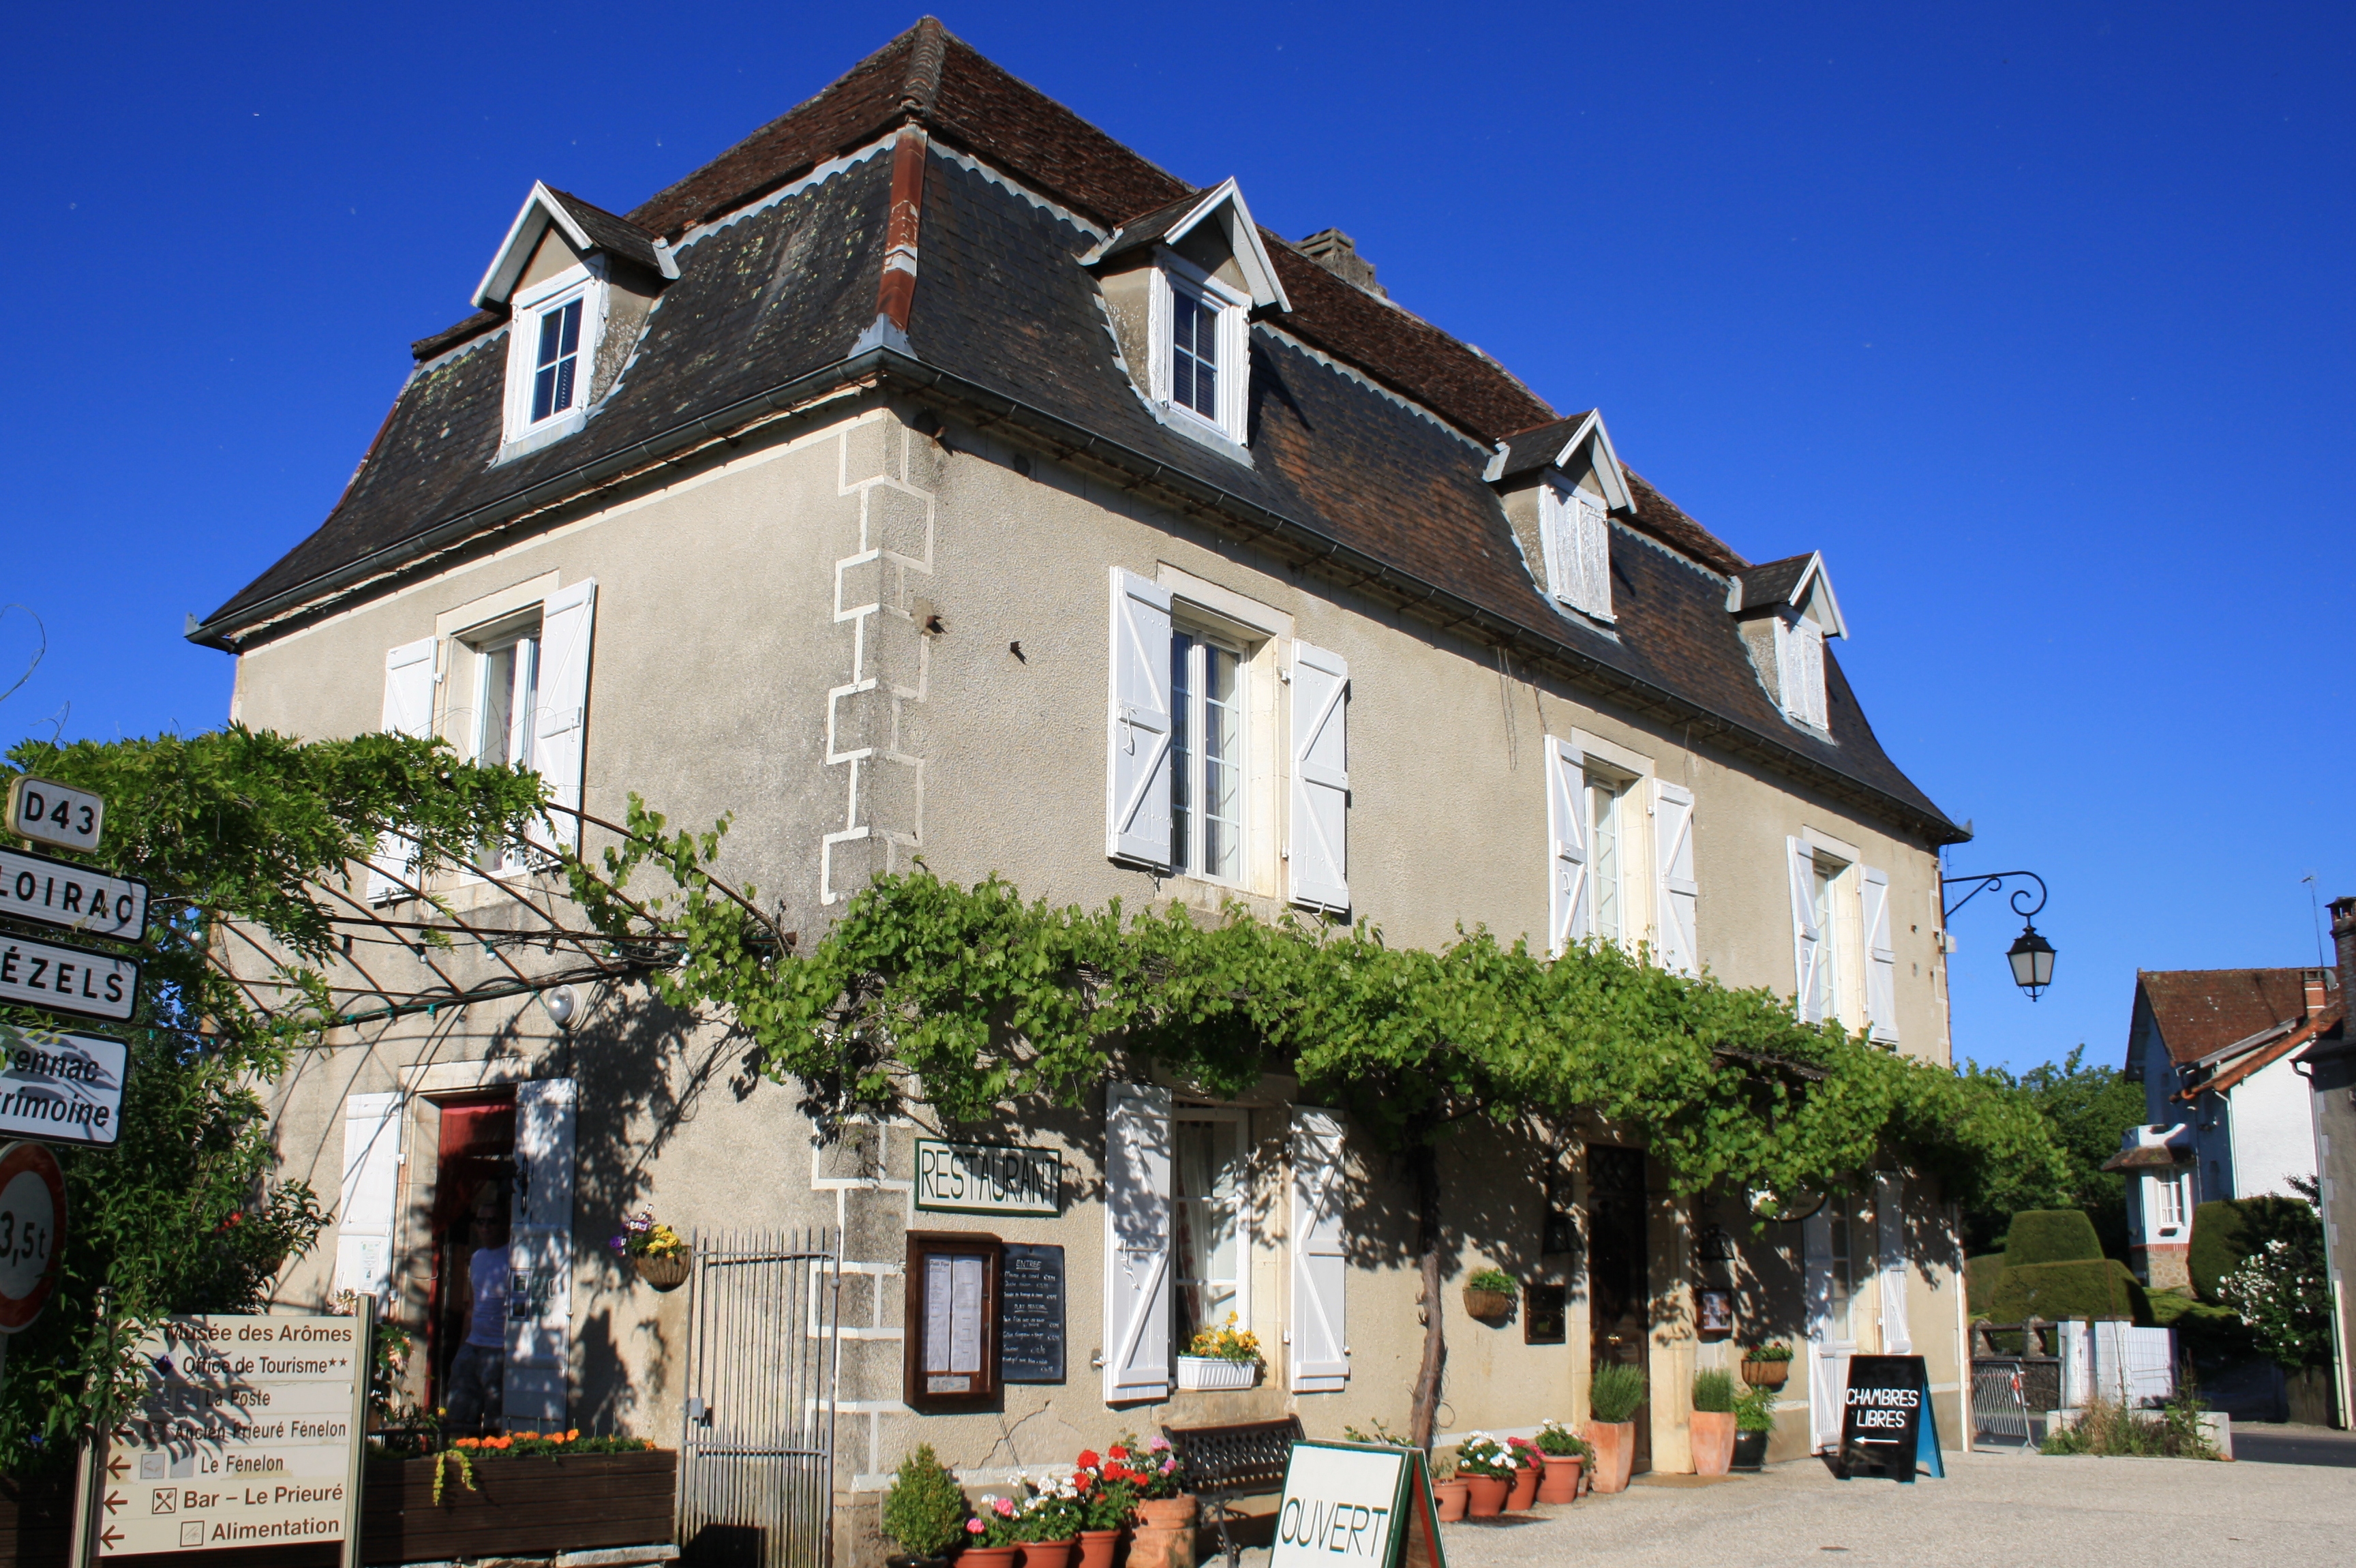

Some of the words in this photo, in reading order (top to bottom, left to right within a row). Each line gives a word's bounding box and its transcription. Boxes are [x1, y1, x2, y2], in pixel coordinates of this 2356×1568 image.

[25, 791, 95, 835] D43
[1, 946, 124, 1003] ÉZELS
[0, 1086, 110, 1128] rimoine
[921, 1148, 1057, 1205] RESTAURANT
[166, 1323, 232, 1341] Musée
[239, 1324, 273, 1341] des
[279, 1325, 352, 1342] Arômes
[183, 1355, 230, 1374] Office
[235, 1357, 254, 1374] de
[205, 1389, 223, 1407] La
[230, 1389, 271, 1406] Poste
[1845, 1387, 1920, 1407] CHAMBRES
[1856, 1409, 1906, 1428] LIBRES
[174, 1423, 226, 1441] Ancien
[232, 1421, 284, 1439] Prieuré
[291, 1420, 346, 1438] Fénelon
[201, 1456, 219, 1474] Le
[226, 1454, 284, 1473] Fénelon
[184, 1490, 220, 1509] Bar
[245, 1488, 268, 1505] Le
[275, 1483, 343, 1504] Prieuré
[211, 1517, 339, 1541] Alimentation
[1281, 1496, 1389, 1558] OUVERT
